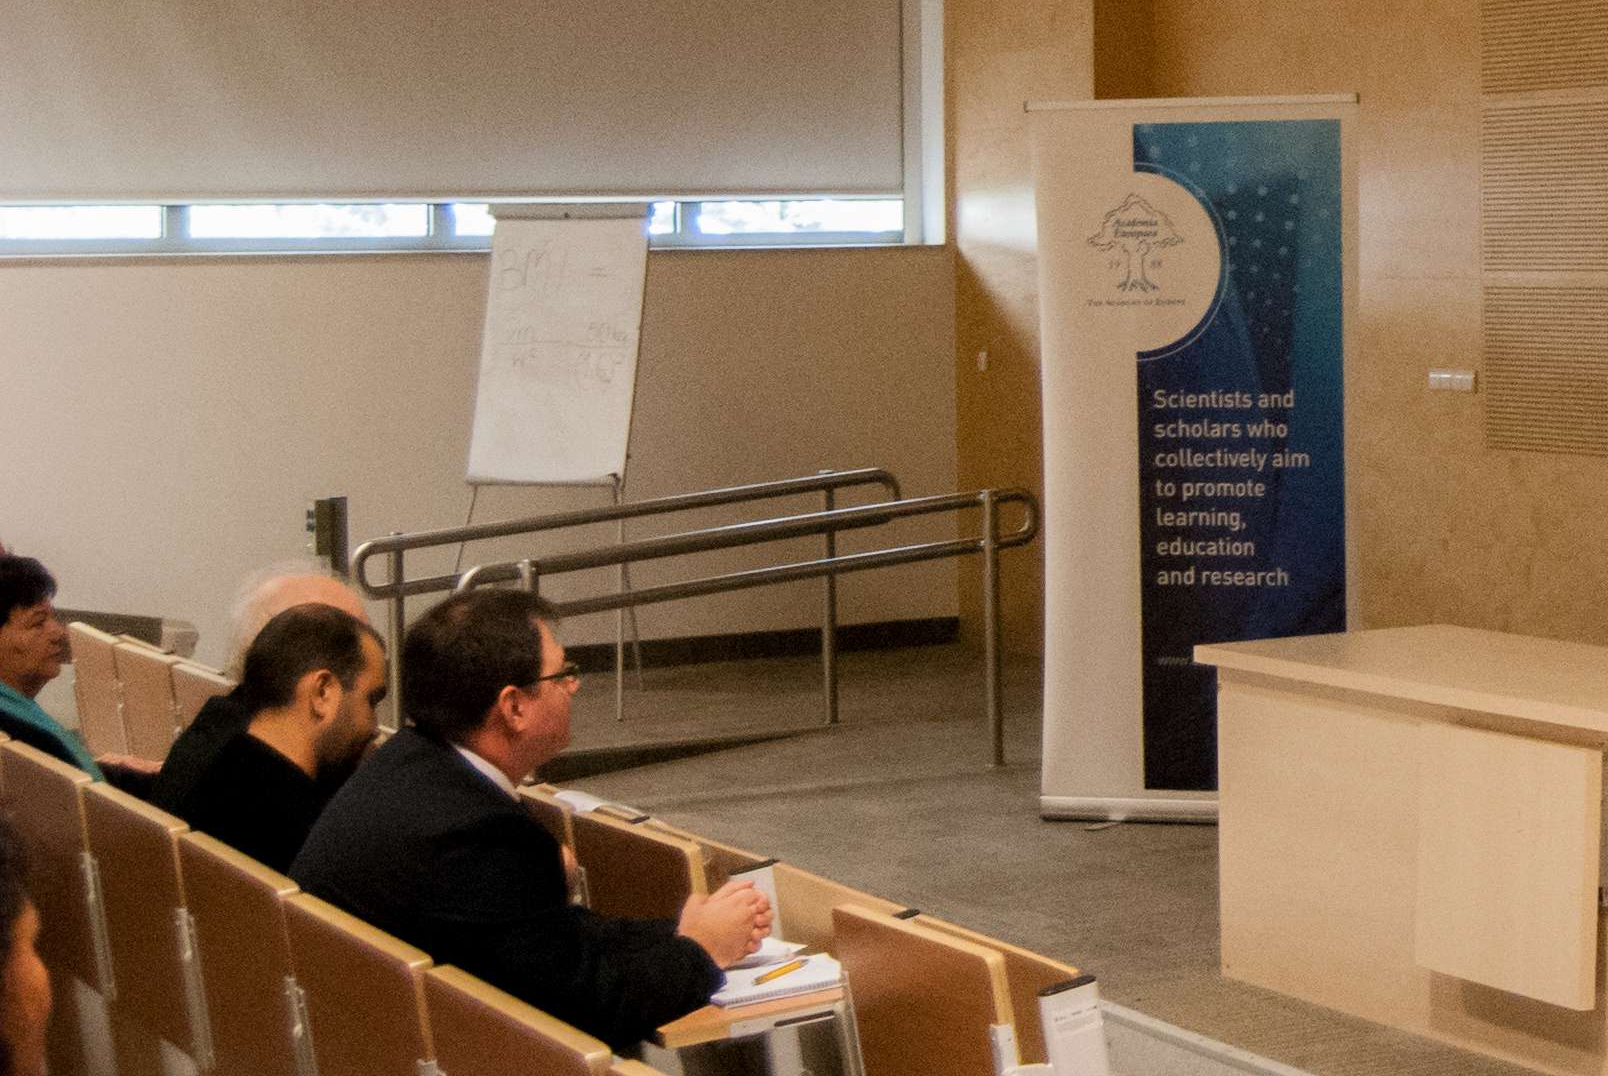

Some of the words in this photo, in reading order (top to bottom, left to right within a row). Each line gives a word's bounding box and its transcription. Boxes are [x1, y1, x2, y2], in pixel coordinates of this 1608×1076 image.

[1153, 389, 1252, 409] Scientists
[1257, 389, 1294, 409] and
[1154, 419, 1242, 438] scholars
[1246, 419, 1288, 438] who
[1155, 448, 1267, 472] collectively
[1272, 448, 1310, 467] aim
[1155, 479, 1176, 497] to
[1182, 479, 1266, 501] promote
[1156, 507, 1246, 531] learning,
[1156, 537, 1255, 556] education
[1157, 566, 1196, 585] and
[1202, 567, 1289, 586] research
